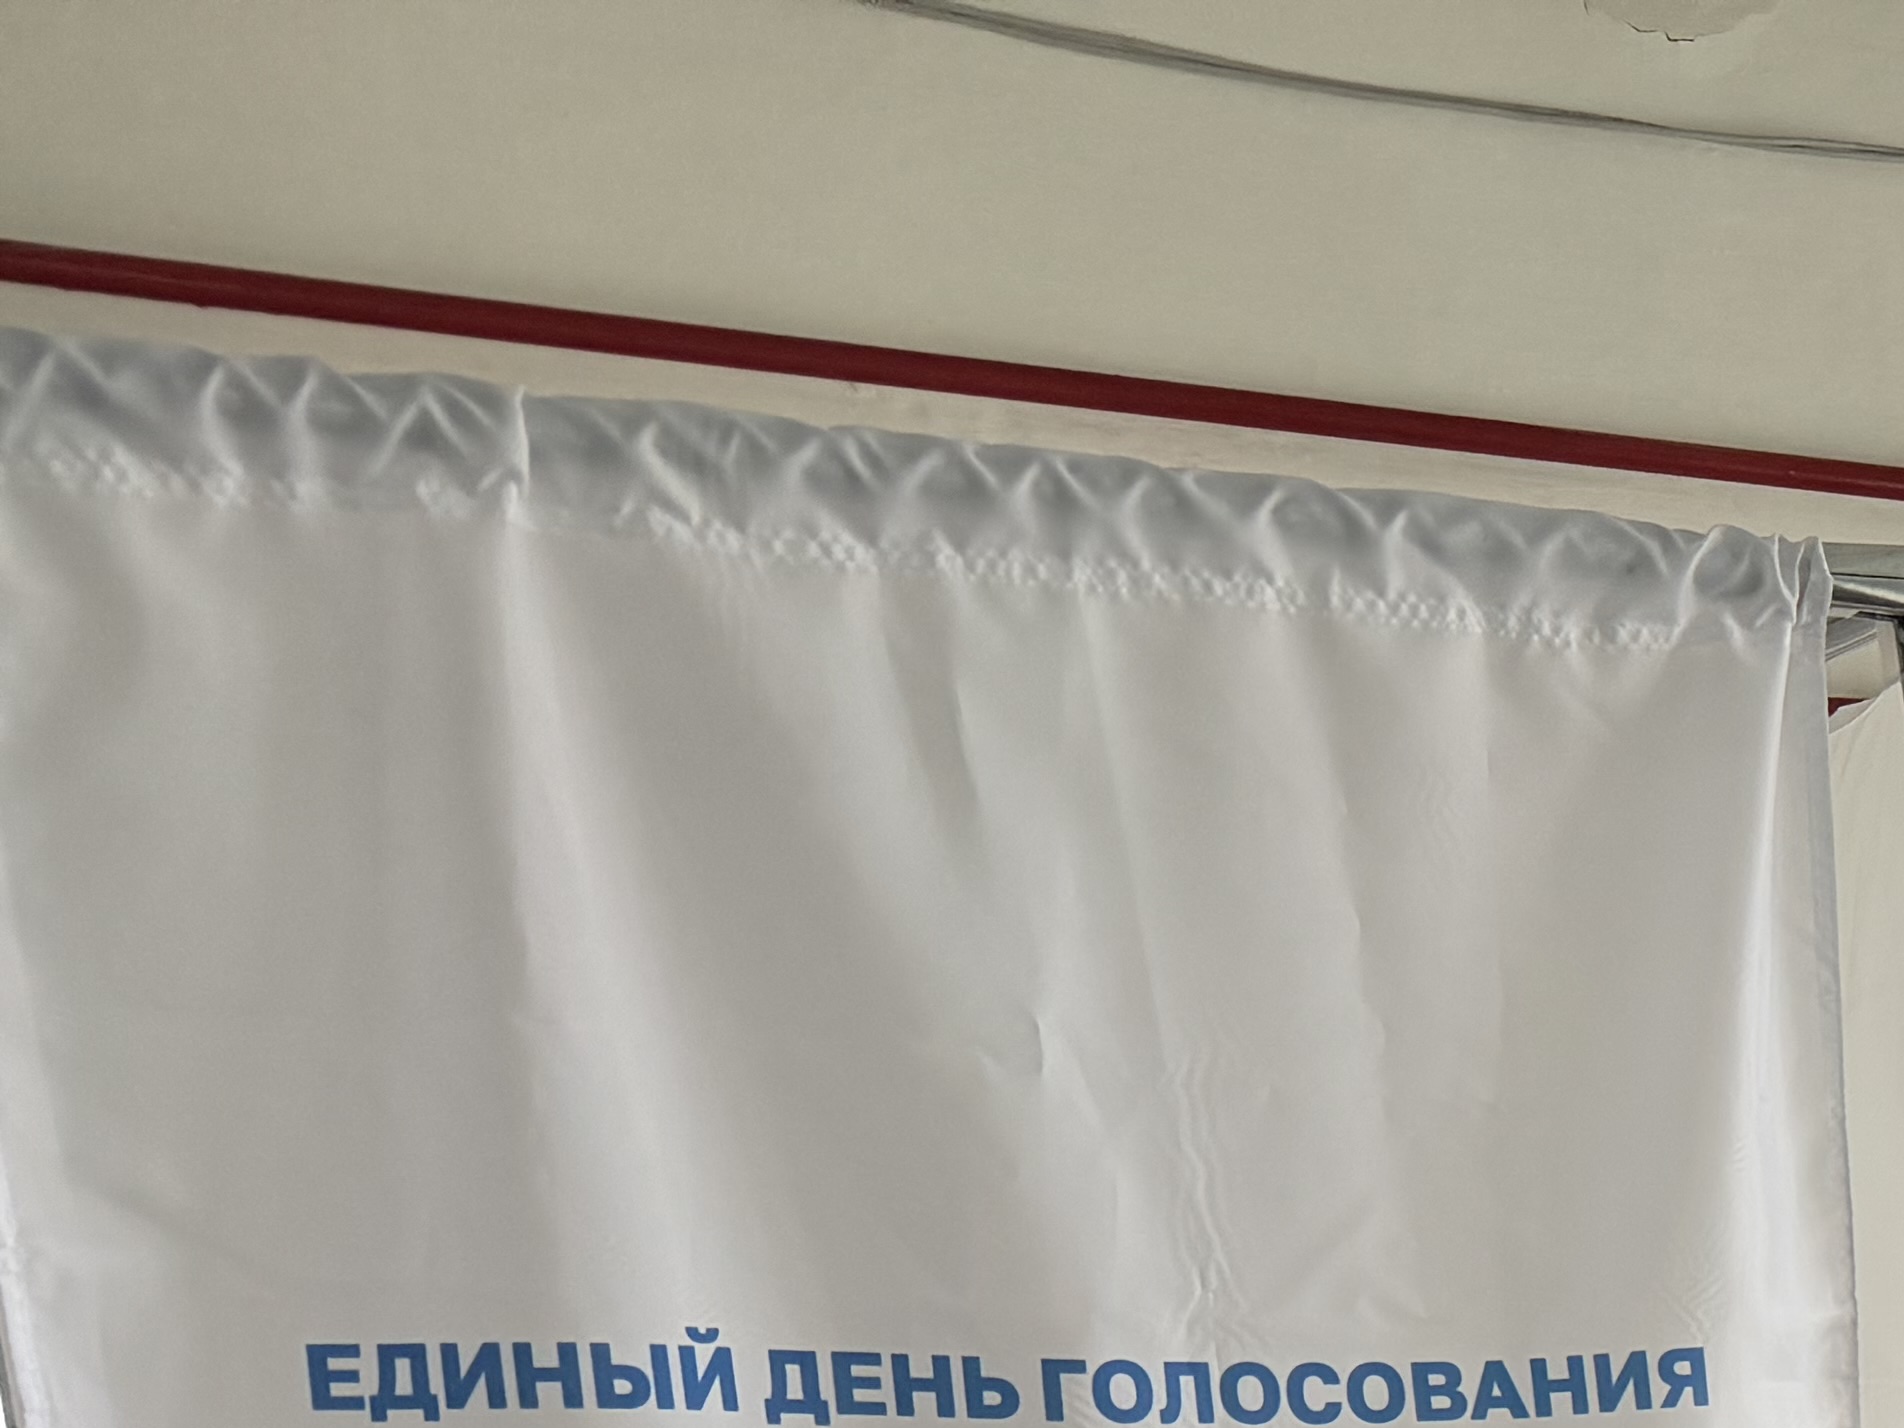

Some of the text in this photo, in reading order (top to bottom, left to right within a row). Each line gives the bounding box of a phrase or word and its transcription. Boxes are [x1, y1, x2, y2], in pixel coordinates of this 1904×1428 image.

[306, 1325, 1710, 1428] ЕДИНЫЙ ДЕНЬ ГОЛОСОВАНИЯ
